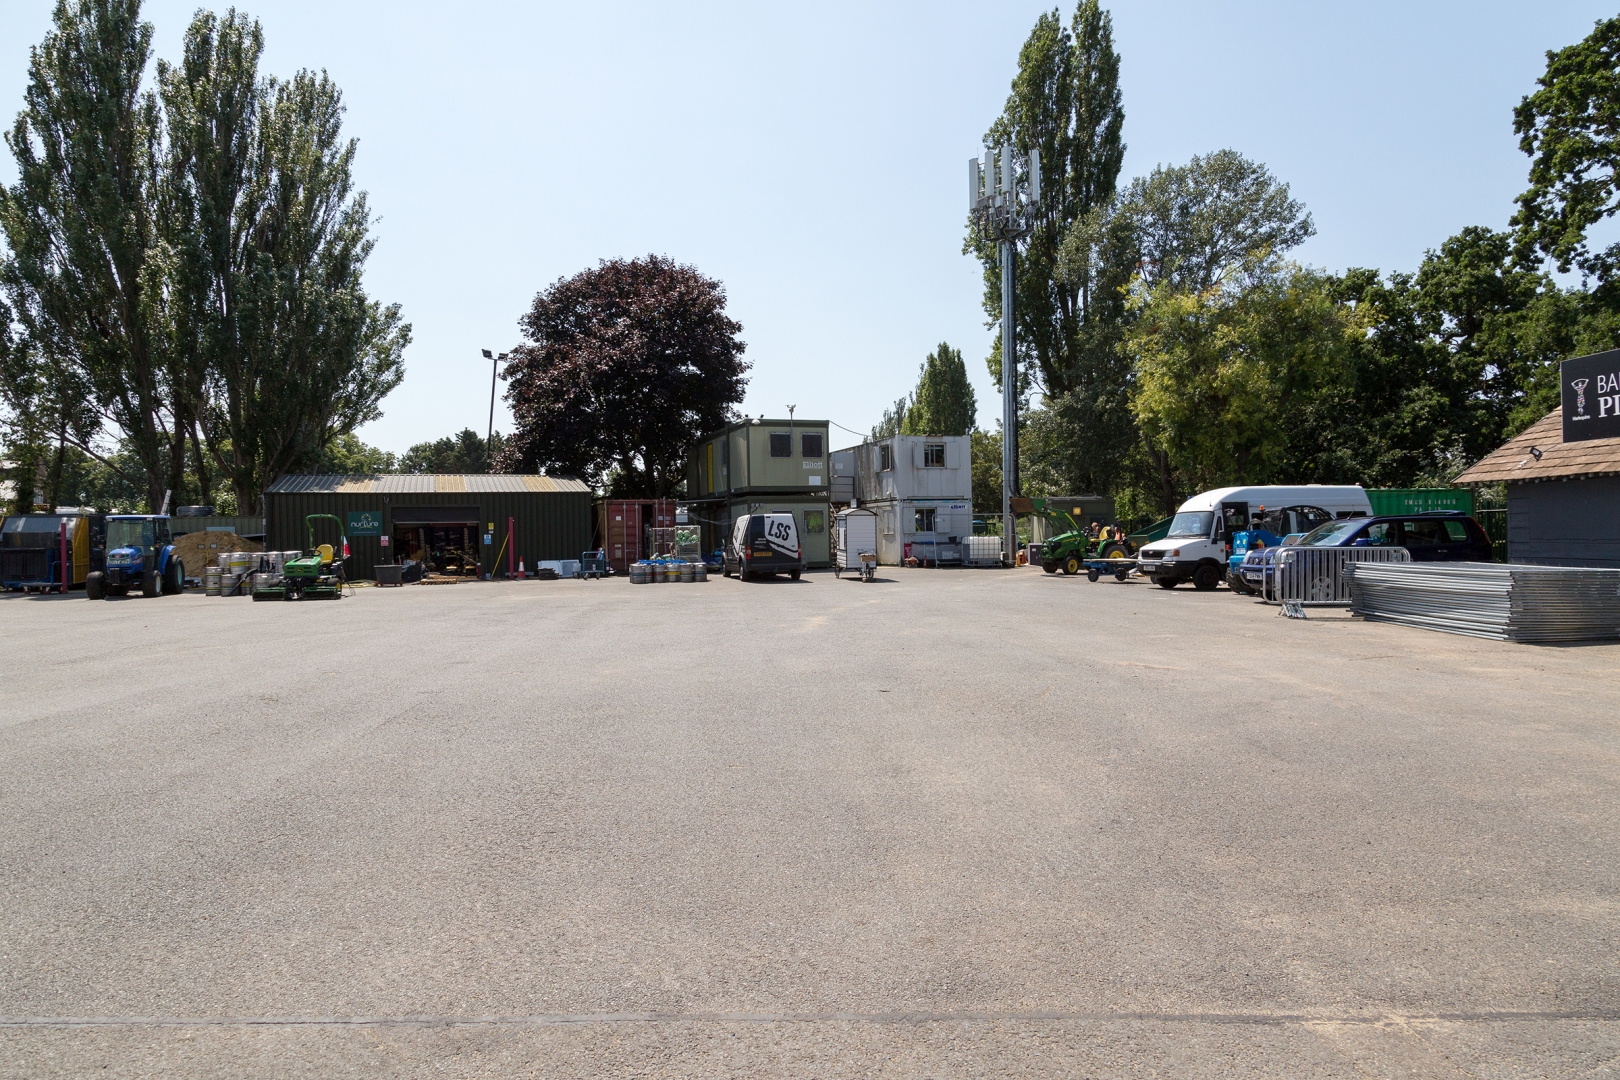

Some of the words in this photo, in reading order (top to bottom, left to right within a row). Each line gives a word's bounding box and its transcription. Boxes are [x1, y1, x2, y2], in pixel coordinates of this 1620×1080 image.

[1597, 371, 1620, 394] BA
[802, 461, 823, 469] Elliott
[350, 520, 379, 528] nurture
[767, 520, 791, 541] LSS
